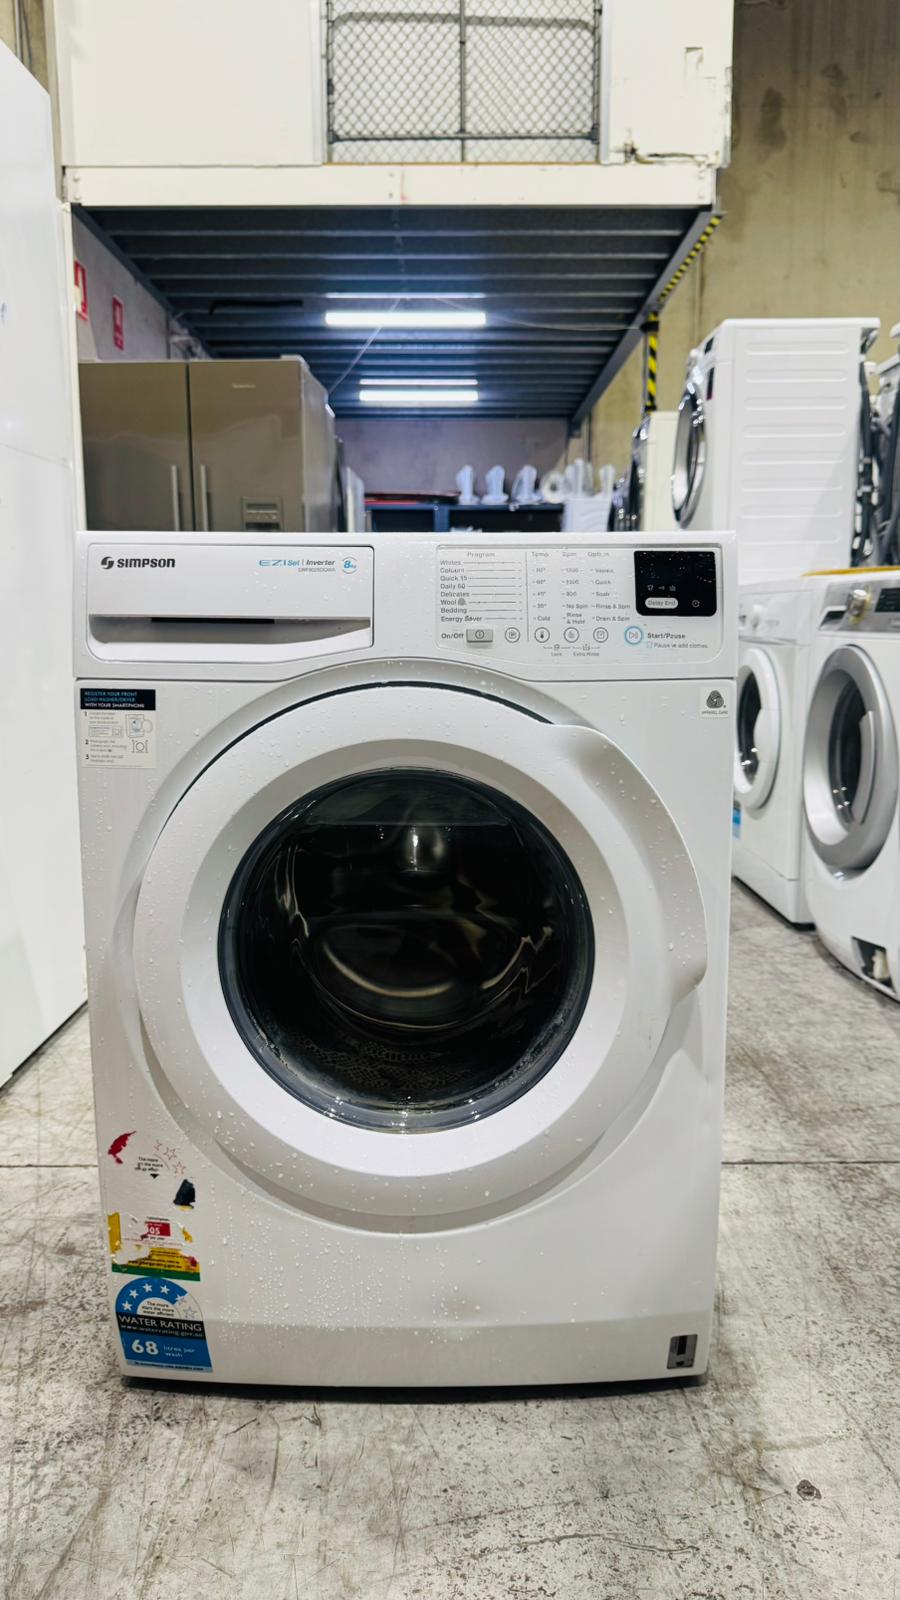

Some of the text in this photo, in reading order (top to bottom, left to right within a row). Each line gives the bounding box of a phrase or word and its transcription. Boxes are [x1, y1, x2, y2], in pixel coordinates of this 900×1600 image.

[117, 558, 176, 568] SIMPSON
[440, 615, 463, 623] Energy
[441, 632, 465, 640] On/Off
[119, 1315, 202, 1332] WATER RATING
[131, 1339, 159, 1355] 68
